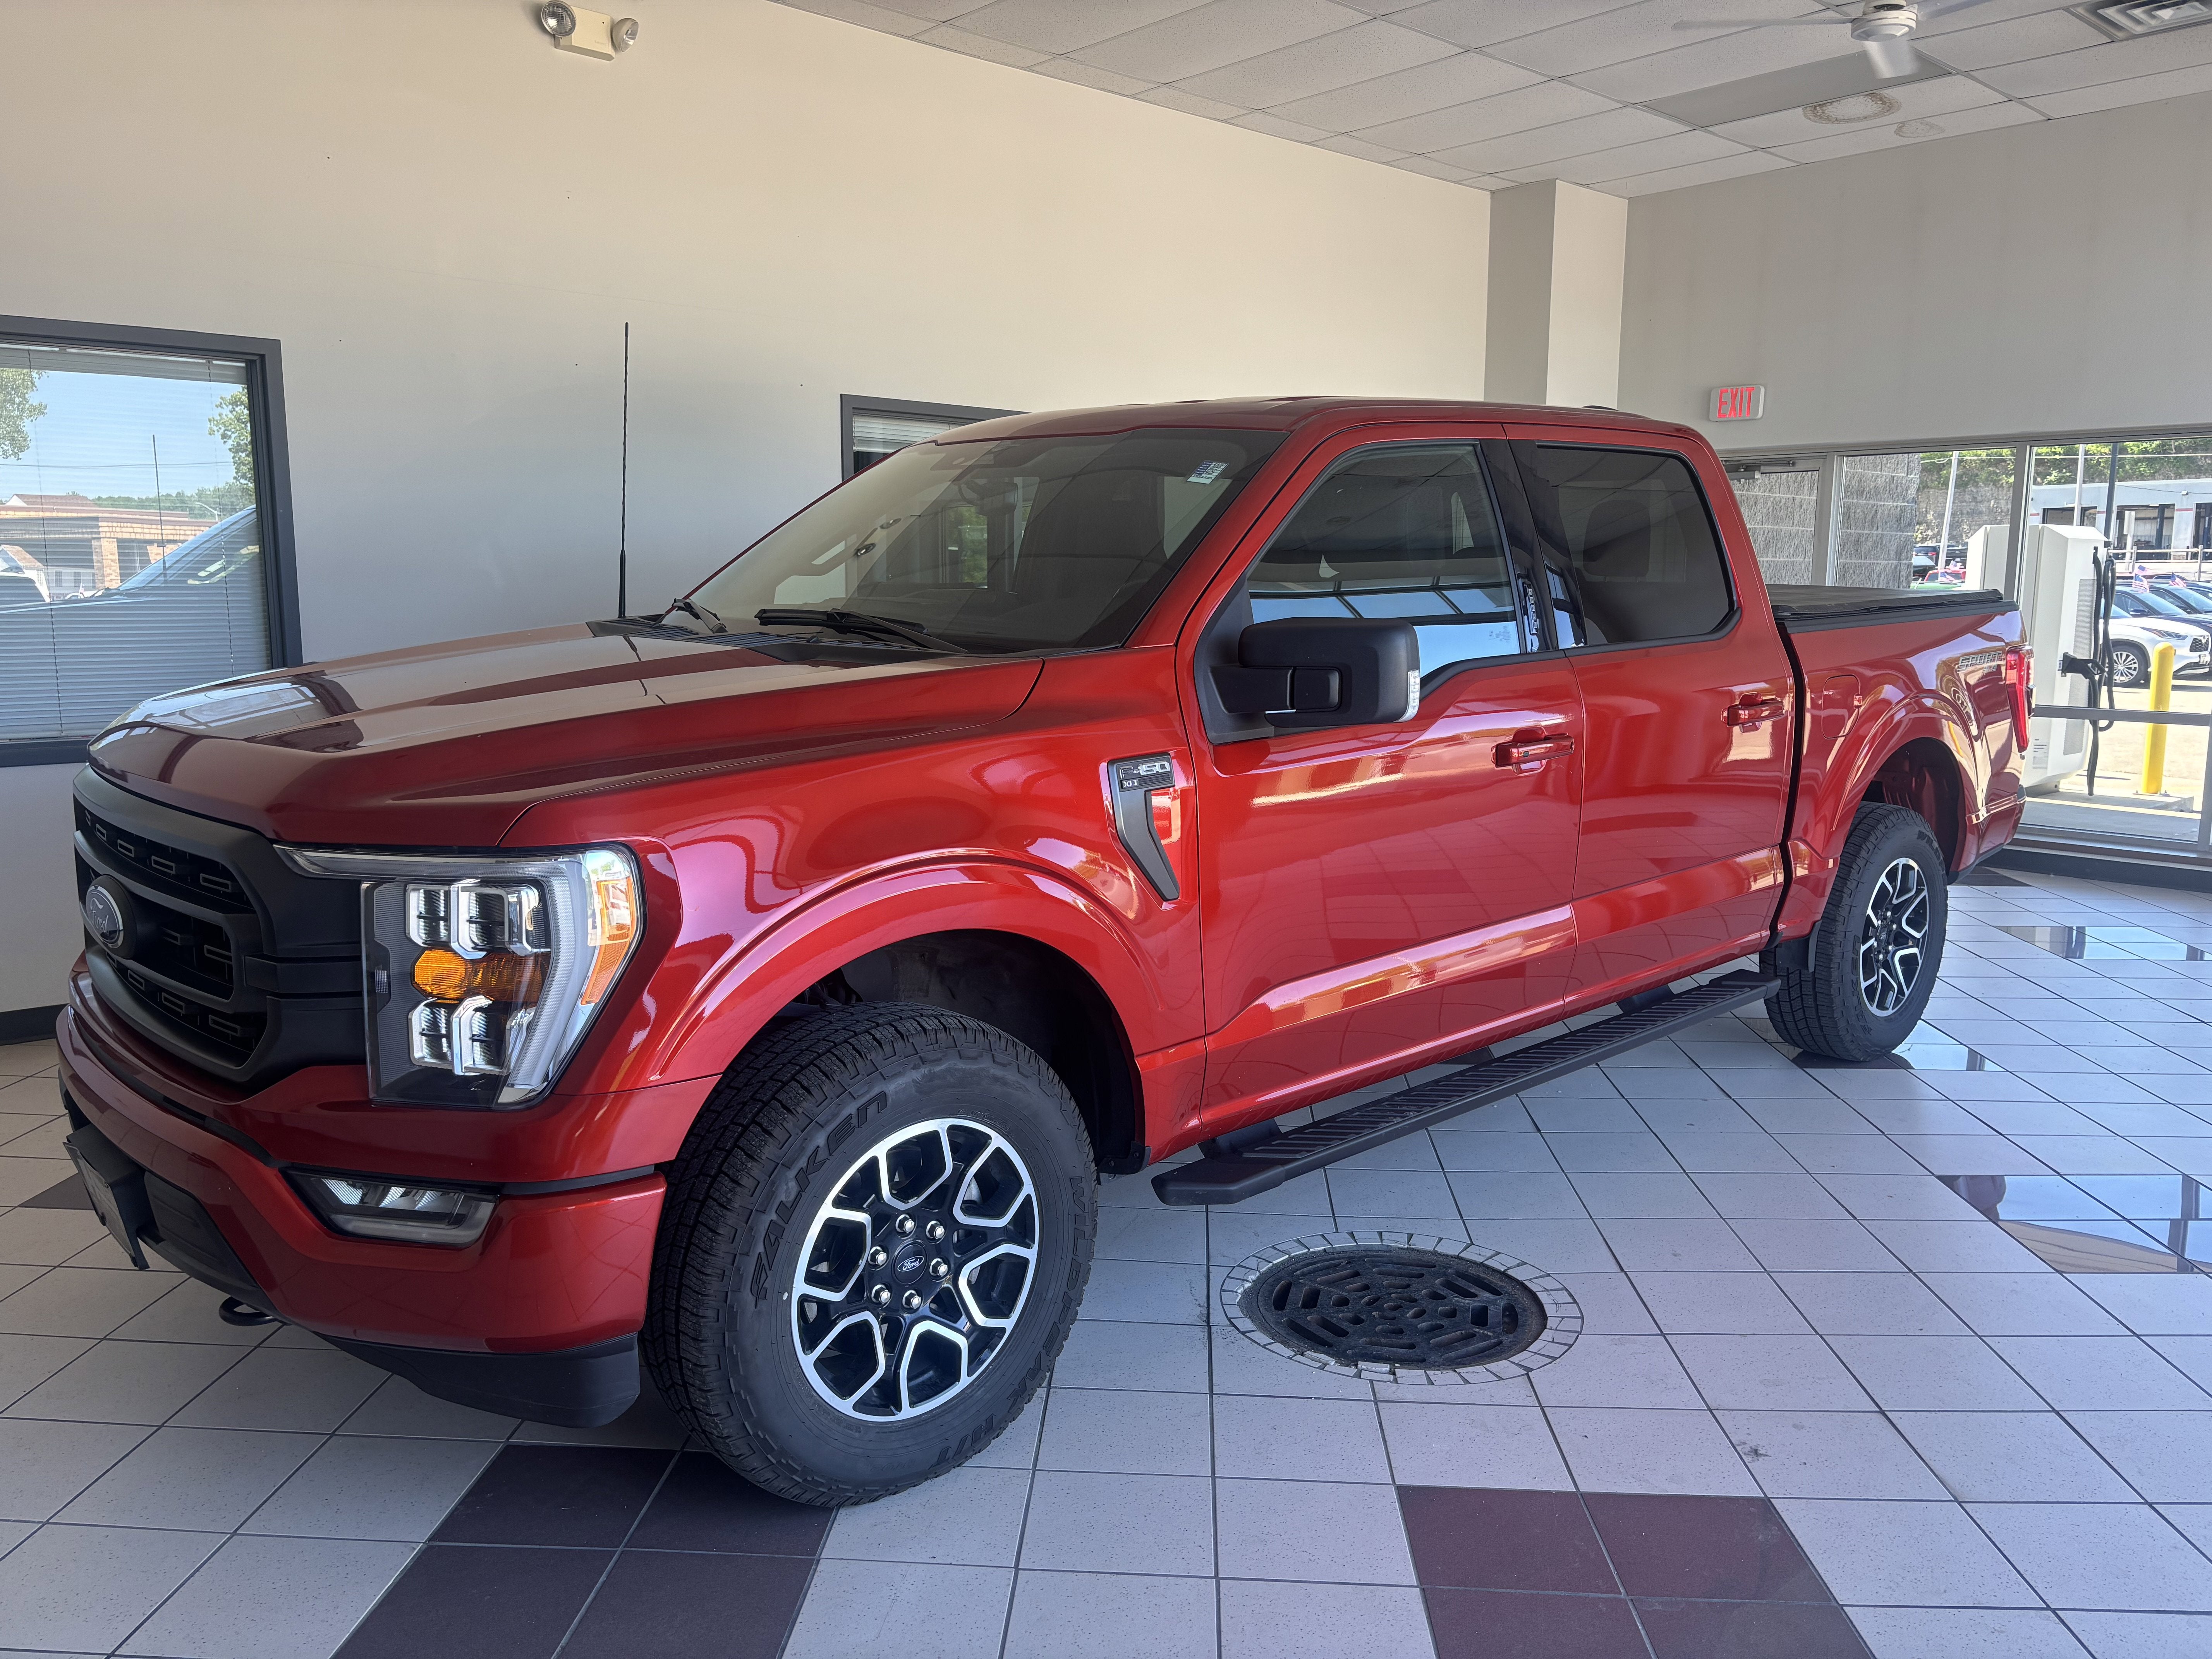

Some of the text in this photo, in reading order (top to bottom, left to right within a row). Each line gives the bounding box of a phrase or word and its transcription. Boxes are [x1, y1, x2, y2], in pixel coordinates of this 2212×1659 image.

[1717, 386, 1755, 418] EXIT
[1957, 651, 2002, 673] SPORT
[1120, 761, 1170, 779] F-150
[90, 898, 110, 936] Ford
[750, 1091, 887, 1309] FALKEN
[903, 1258, 920, 1270] Ford
[1007, 1176, 1087, 1413] WILDPEAK
